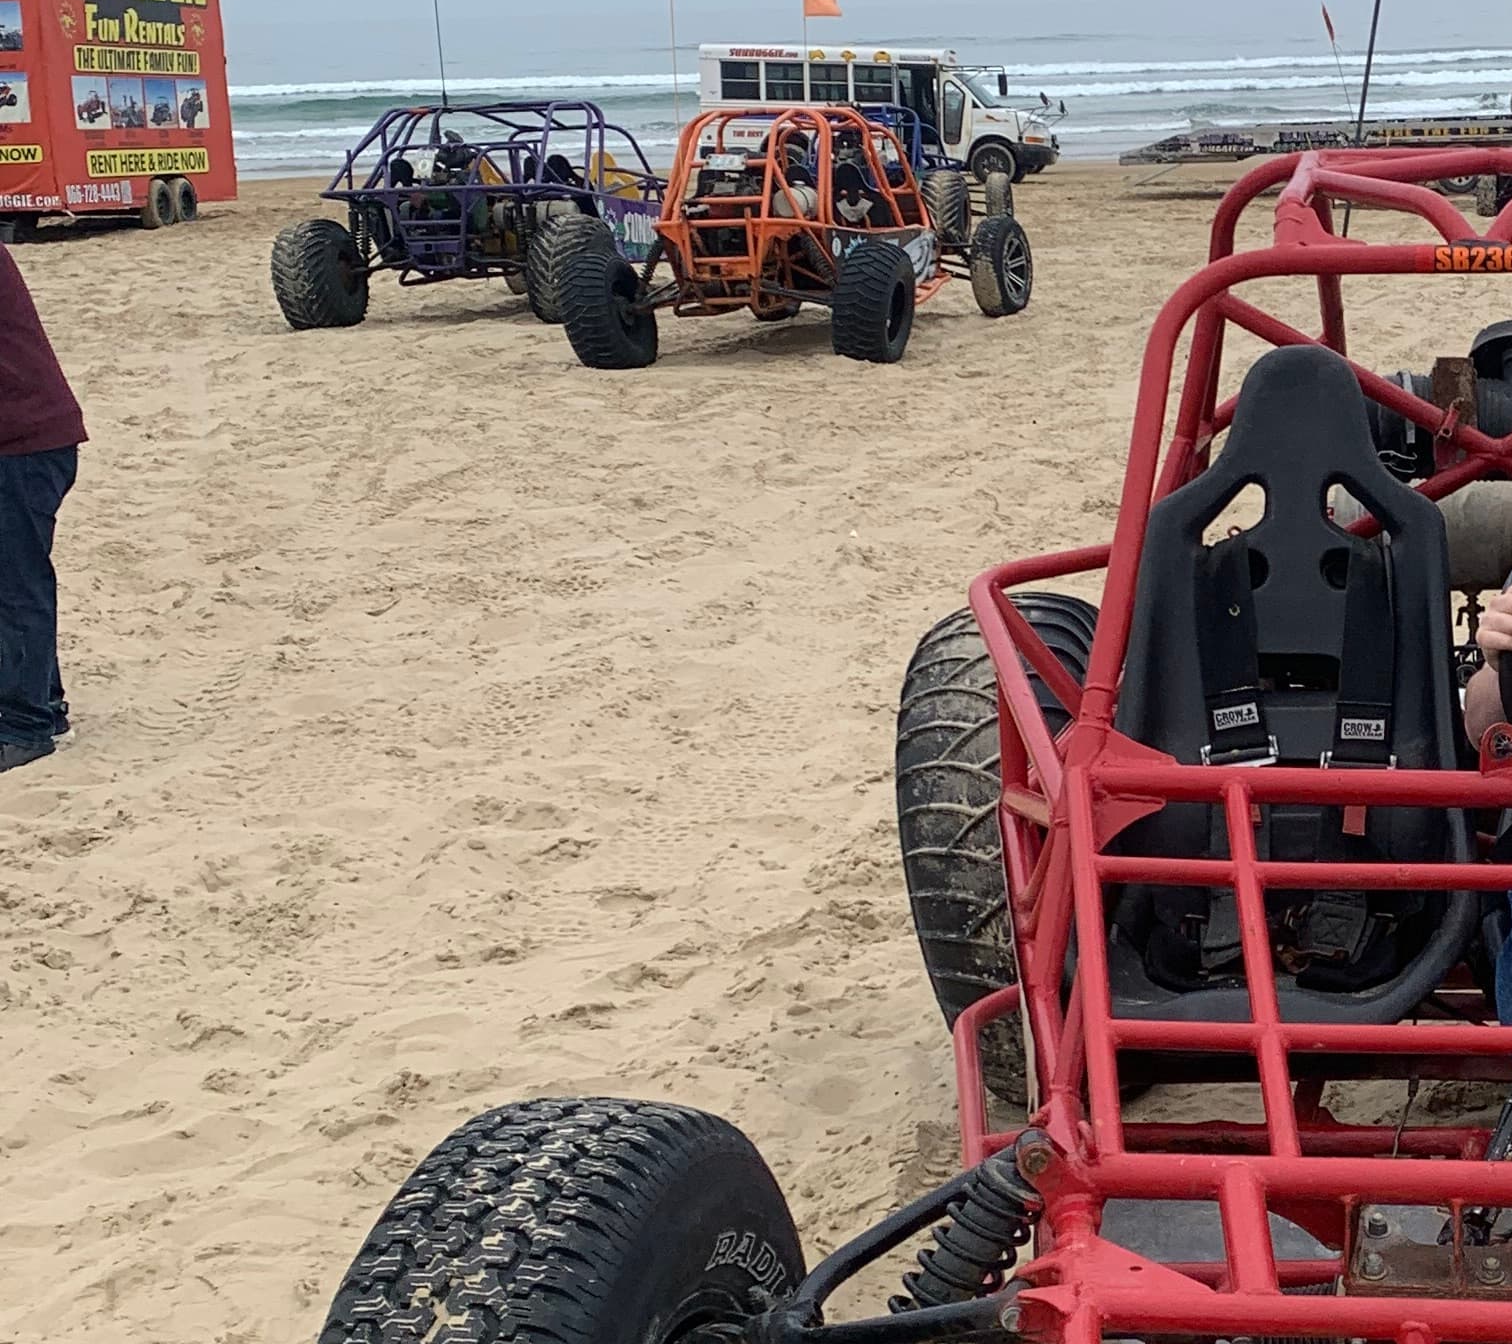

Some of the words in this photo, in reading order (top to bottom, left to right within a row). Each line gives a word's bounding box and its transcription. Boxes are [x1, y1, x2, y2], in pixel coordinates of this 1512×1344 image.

[84, 3, 120, 43] FUN
[123, 7, 186, 47] RENTALS
[76, 47, 95, 69] THE
[97, 48, 142, 71] ULTIMATE
[144, 51, 175, 72] FAMILY
[176, 52, 198, 73] FUN!
[90, 154, 118, 175] RENT
[120, 152, 147, 173] HERE
[148, 152, 156, 172] &
[157, 151, 180, 171] RIDE
[181, 150, 206, 170] NOW
[1215, 708, 1244, 726] CROW
[1343, 722, 1373, 733] CROW
[704, 1231, 796, 1299] RADI
